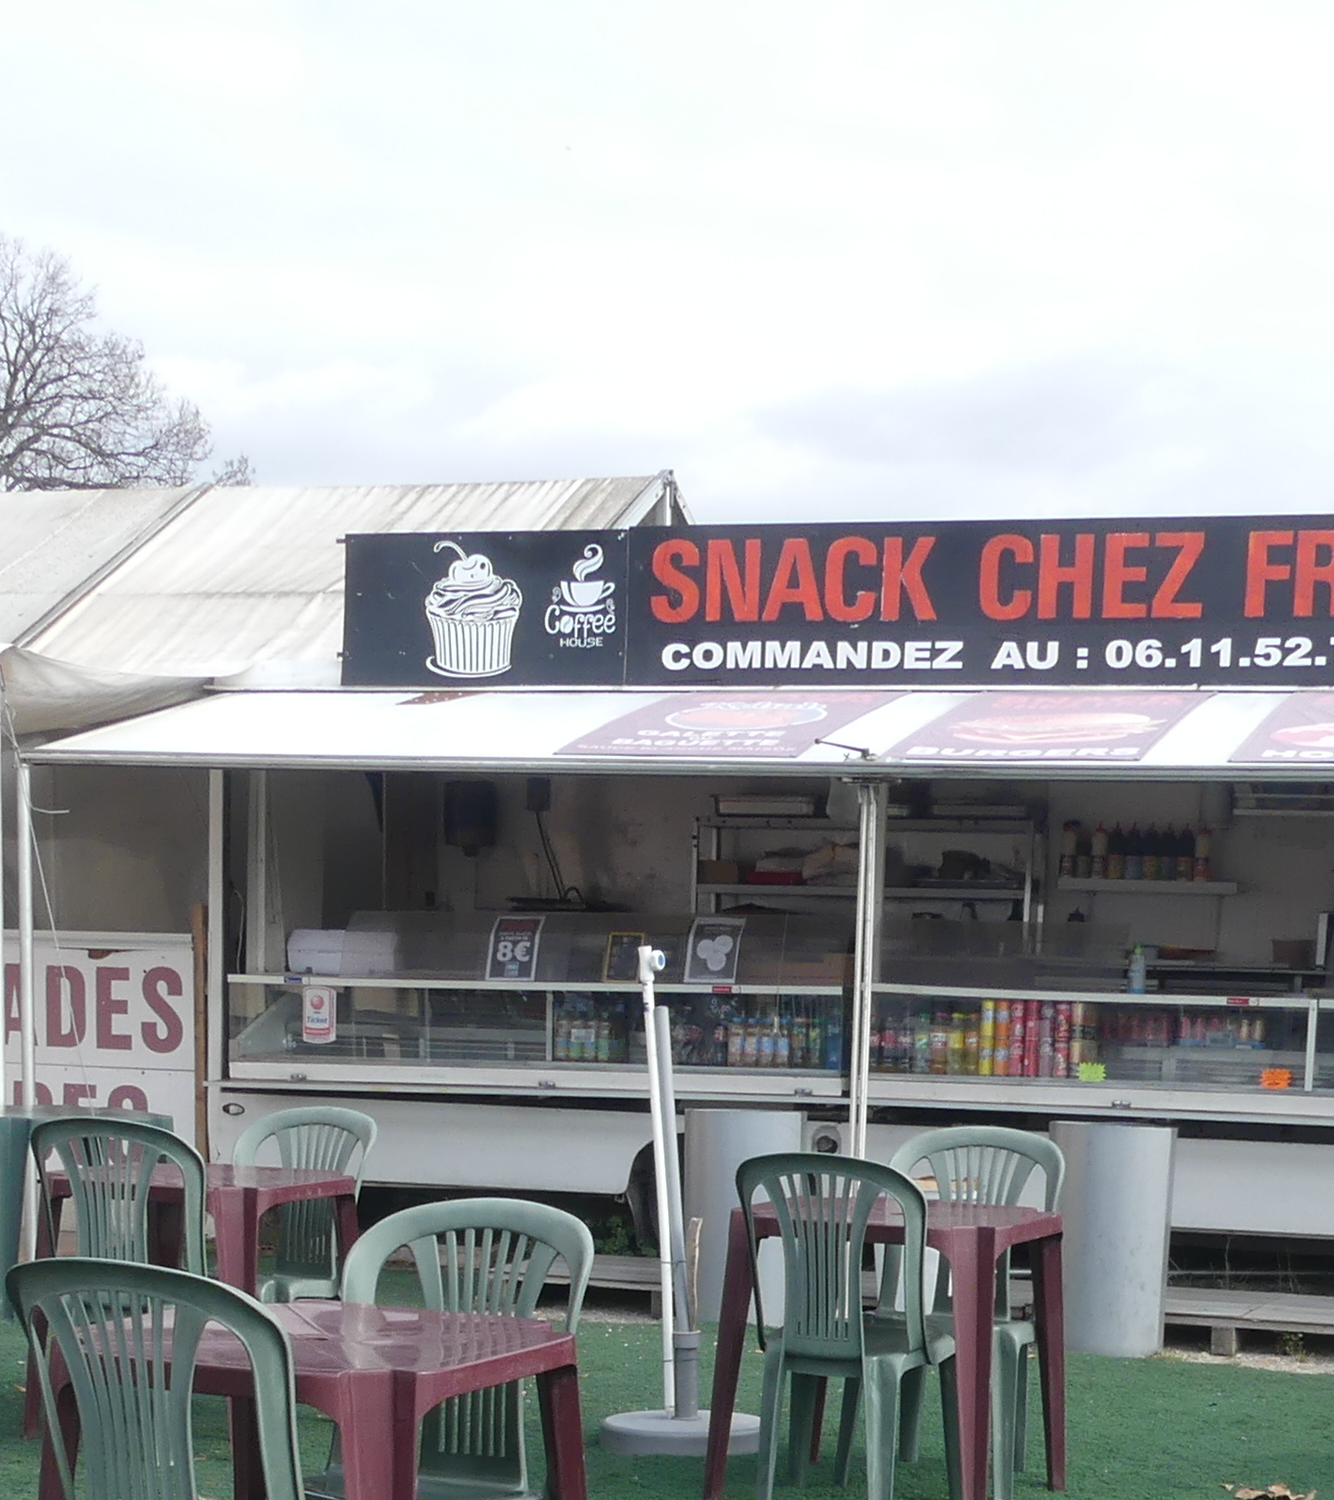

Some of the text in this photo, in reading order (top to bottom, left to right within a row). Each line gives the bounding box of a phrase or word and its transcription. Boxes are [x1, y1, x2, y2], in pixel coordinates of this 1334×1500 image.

[652, 537, 936, 622] SNACK
[979, 533, 1204, 620] CHEZ
[544, 604, 617, 639] Coffee
[560, 637, 604, 648] HOUSE
[662, 641, 964, 671] COMMANDEZ
[991, 641, 1060, 670] AU
[1076, 647, 1089, 669] :
[611, 738, 781, 746] BAGUETTE
[636, 730, 787, 738] GALETTE
[905, 746, 1141, 757] BURGERS
[497, 941, 531, 962] 8€
